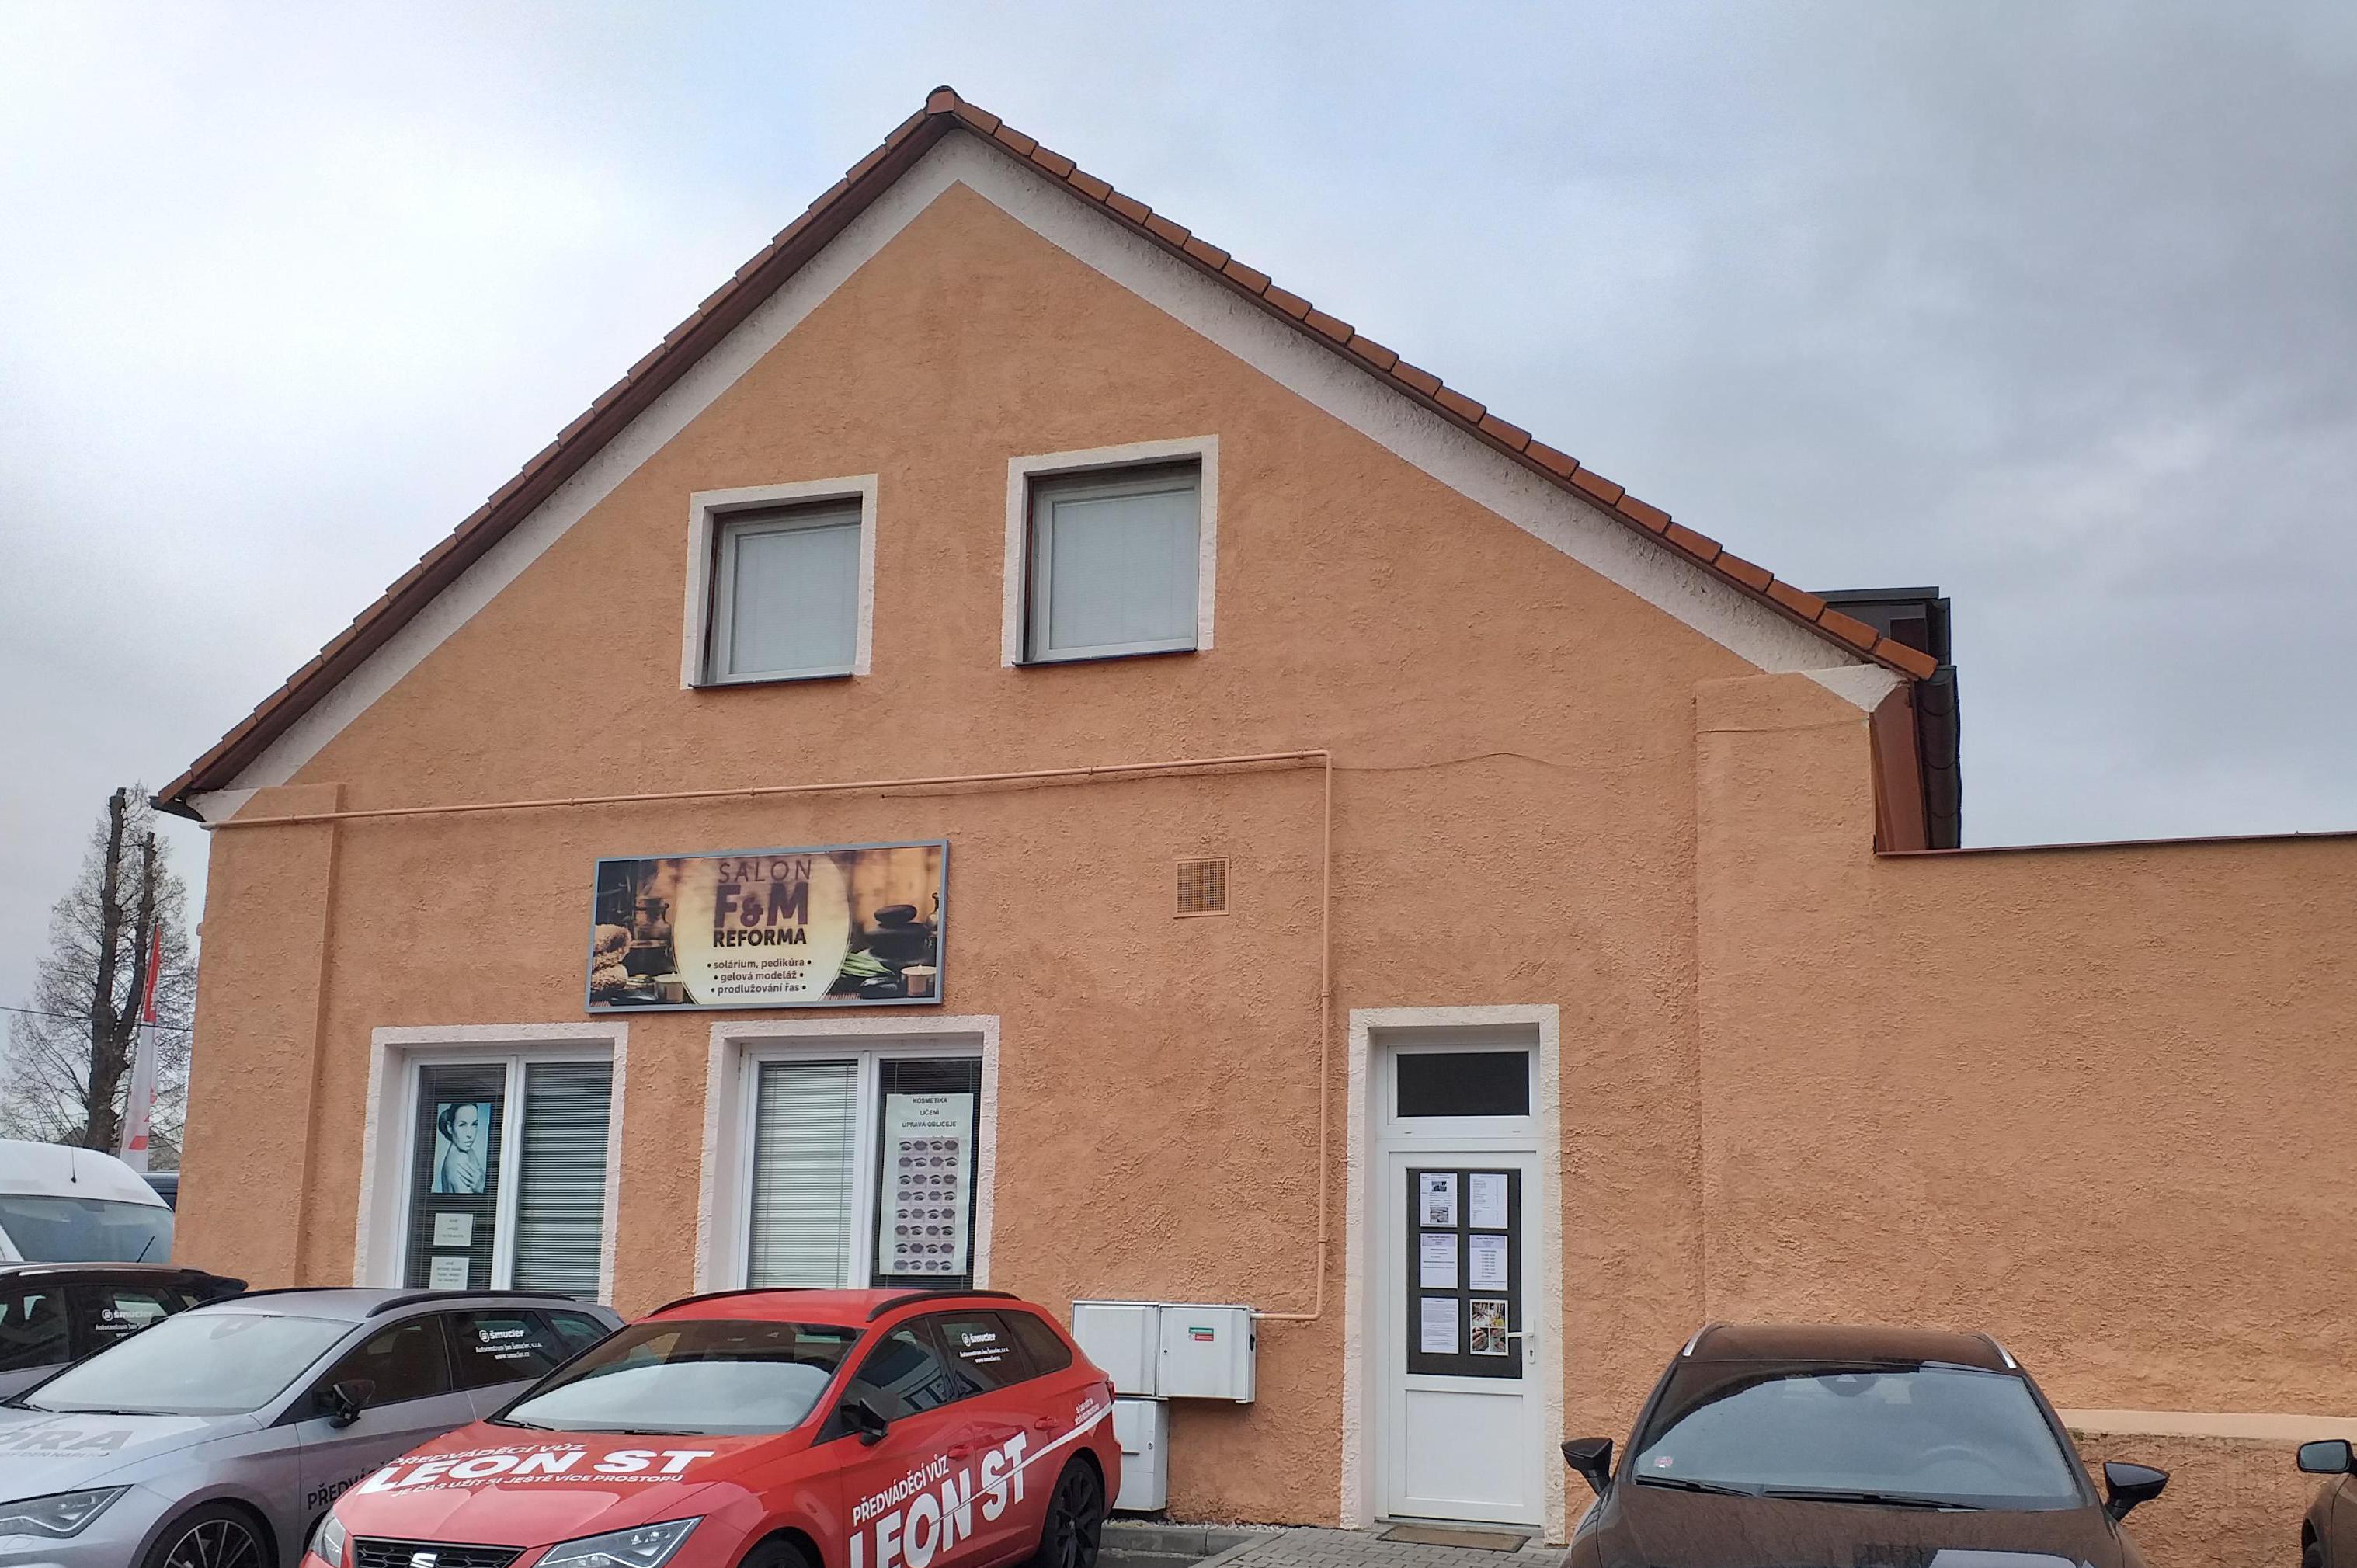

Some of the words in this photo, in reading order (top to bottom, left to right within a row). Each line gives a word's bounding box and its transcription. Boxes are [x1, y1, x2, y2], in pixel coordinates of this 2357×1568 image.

[718, 860, 811, 883] SALON
[714, 881, 808, 927] F&M
[713, 928, 807, 947] REFORMA
[714, 959, 758, 969] solárium,
[761, 958, 805, 969] pedikúra
[721, 971, 753, 983] gelová
[756, 970, 797, 979] modeláž
[718, 982, 782, 996] prodlužování
[784, 982, 799, 992] řas
[386, 1445, 537, 1466] PŘEDVÁDĚCÍ
[539, 1443, 588, 1452] VŮZ
[355, 1450, 588, 1496] LEON
[593, 1449, 715, 1474] ST
[412, 1483, 447, 1493] ČAS
[447, 1478, 487, 1489] UŽÍT
[503, 1475, 554, 1484] JEŠTĚ
[554, 1473, 593, 1483] VÍCE
[981, 1431, 1027, 1522] ST
[852, 1463, 926, 1528] PŘEDVÁDĚCÍ
[926, 1453, 950, 1483] VŮZ
